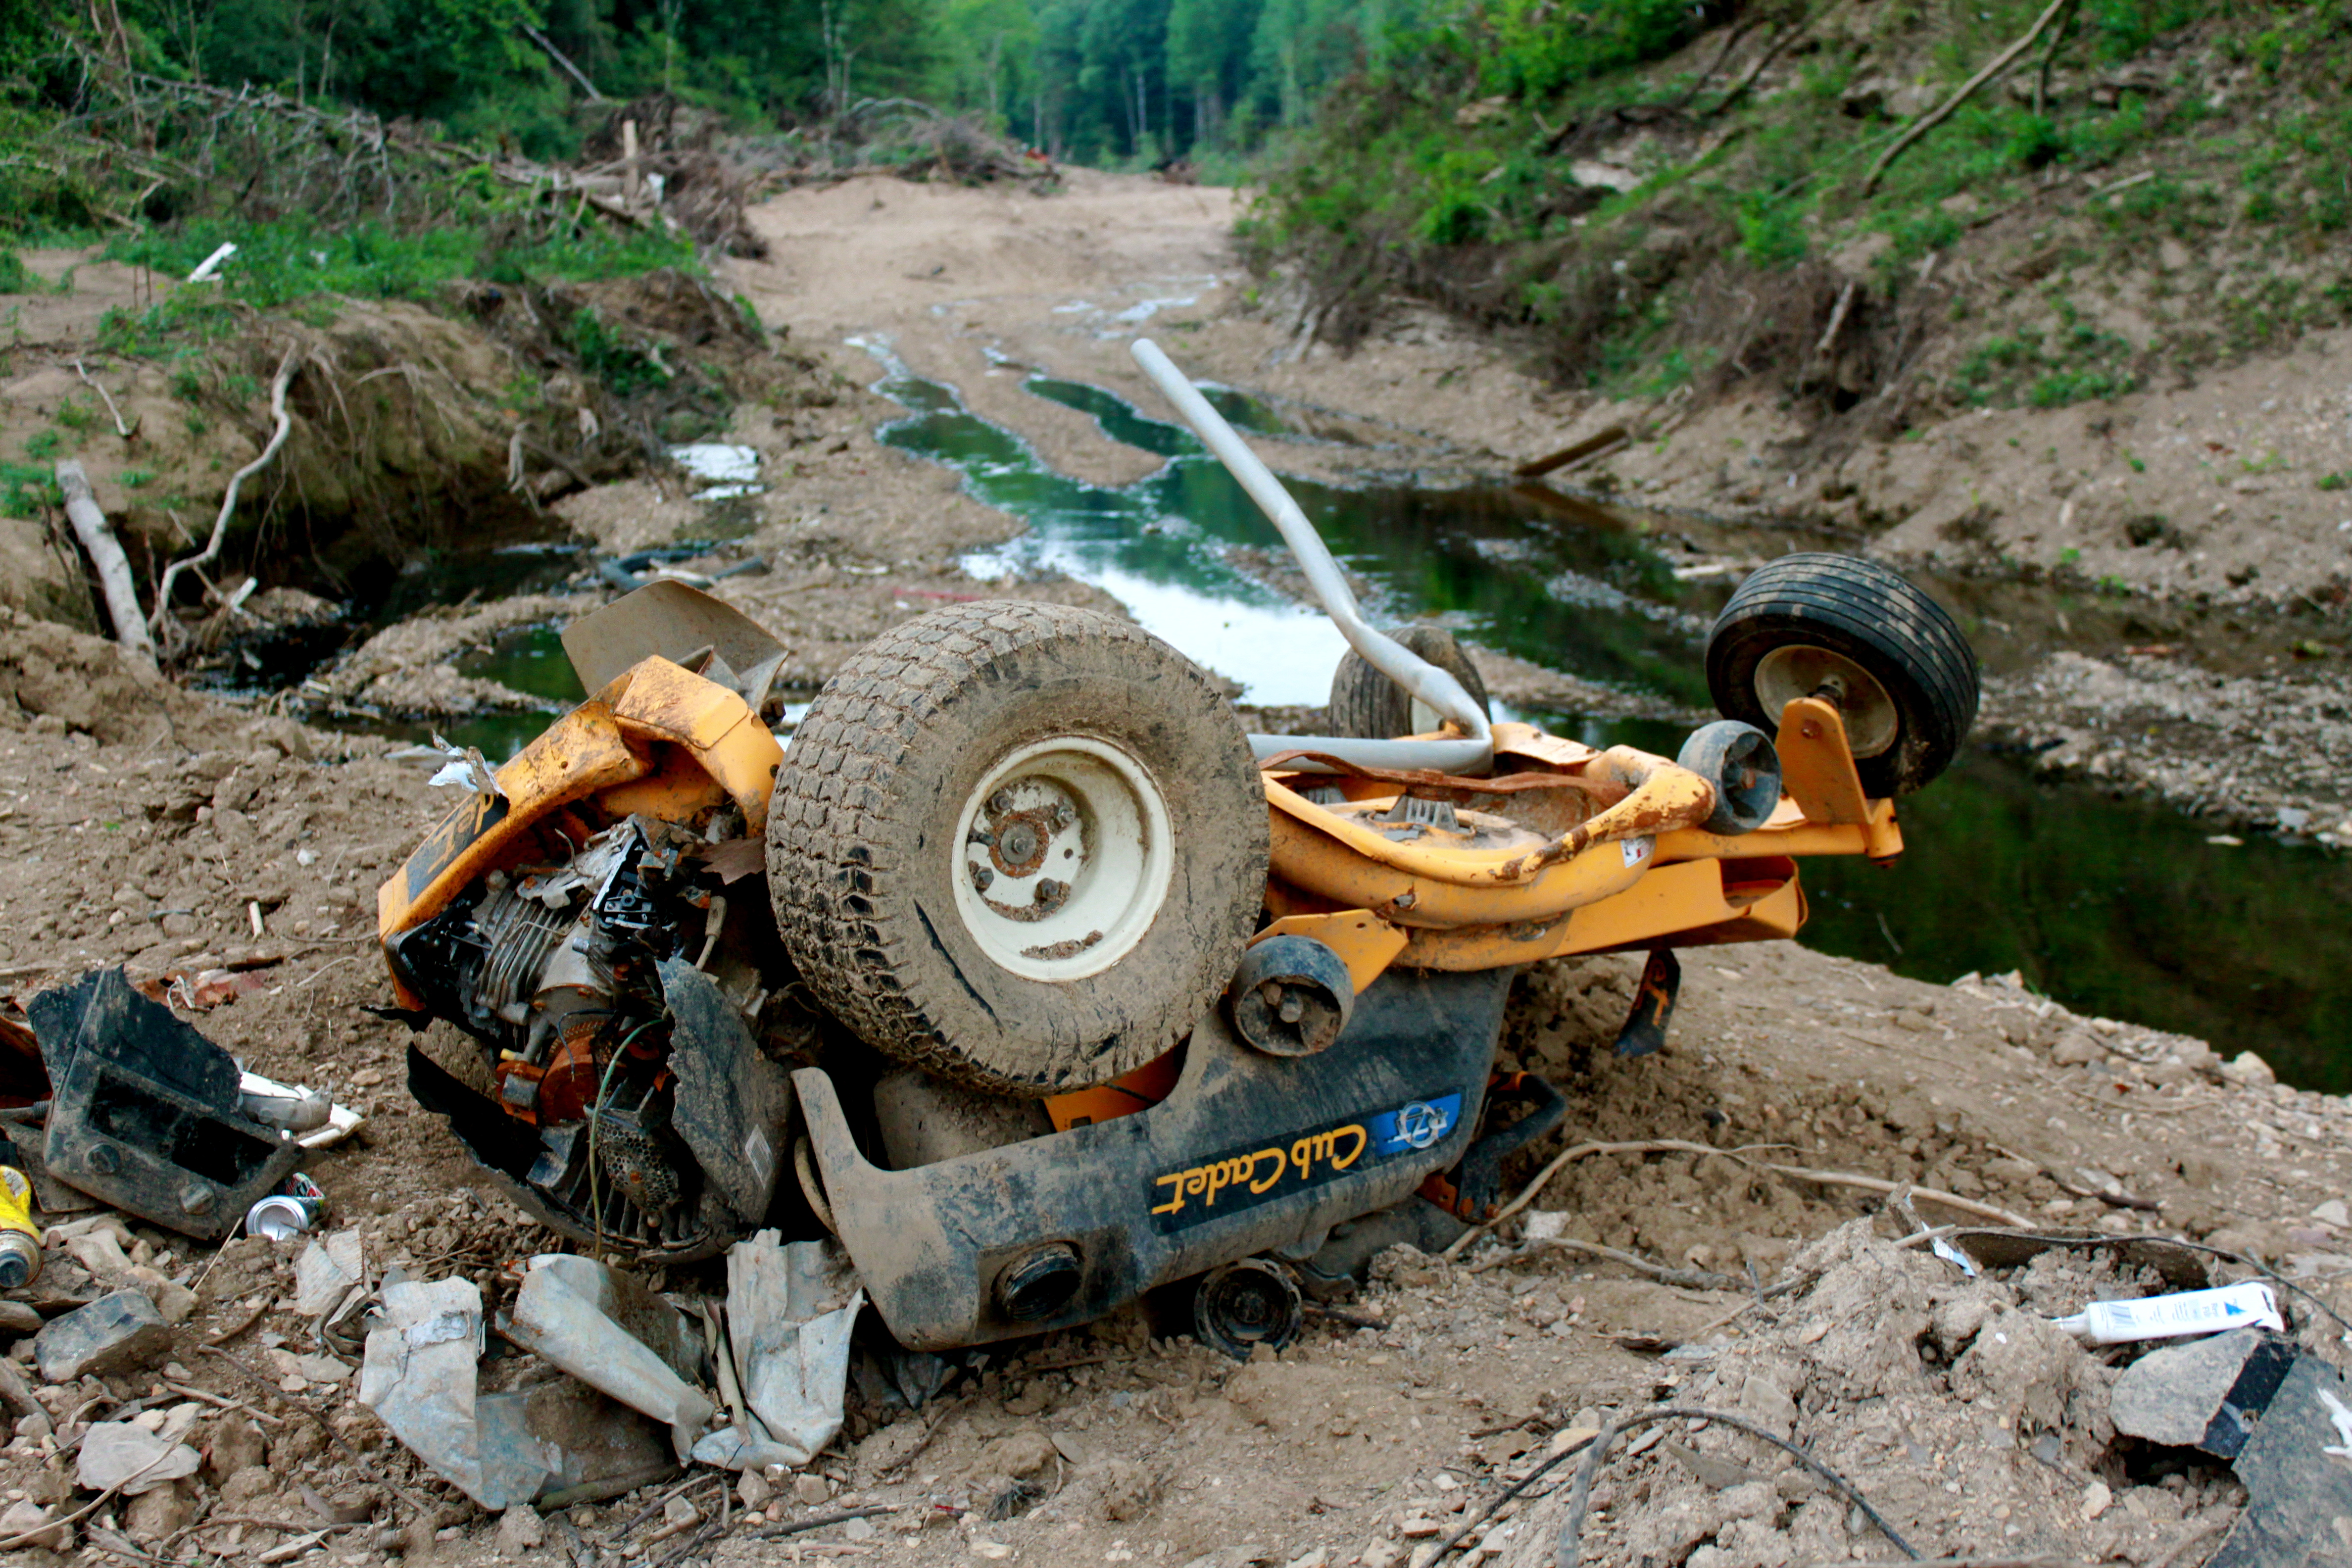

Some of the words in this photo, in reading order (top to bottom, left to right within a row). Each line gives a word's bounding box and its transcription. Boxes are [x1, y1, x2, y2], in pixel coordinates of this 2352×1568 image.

[427, 792, 494, 874] det
[1151, 1147, 1286, 1215] Cadet
[1290, 1124, 1367, 1179] Cub
